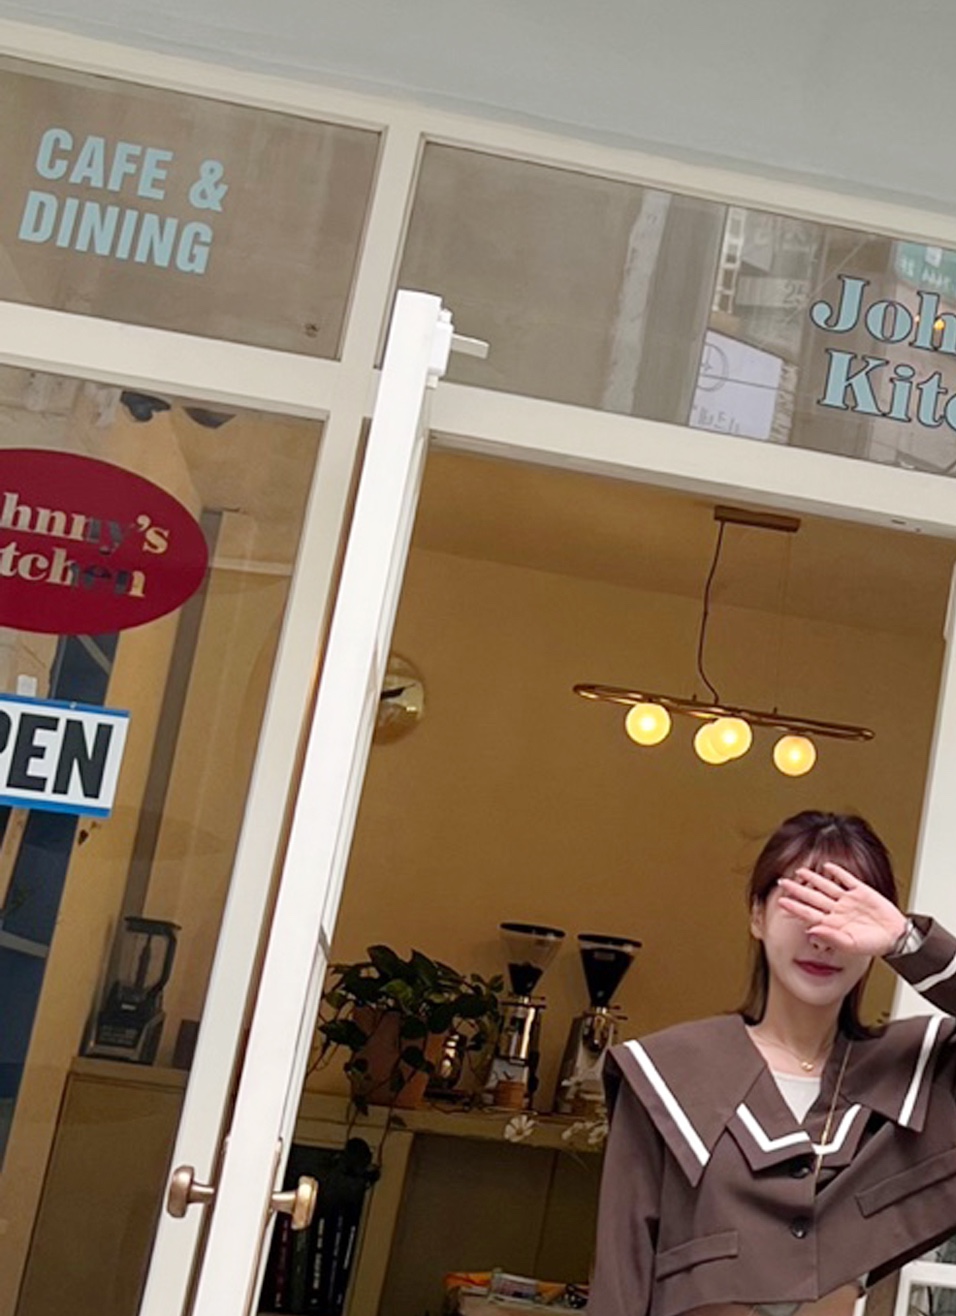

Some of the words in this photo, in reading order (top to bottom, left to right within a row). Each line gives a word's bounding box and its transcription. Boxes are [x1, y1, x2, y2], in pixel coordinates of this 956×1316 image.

[36, 128, 173, 200] CAFE
[189, 160, 228, 212] &
[18, 190, 213, 274] DINING
